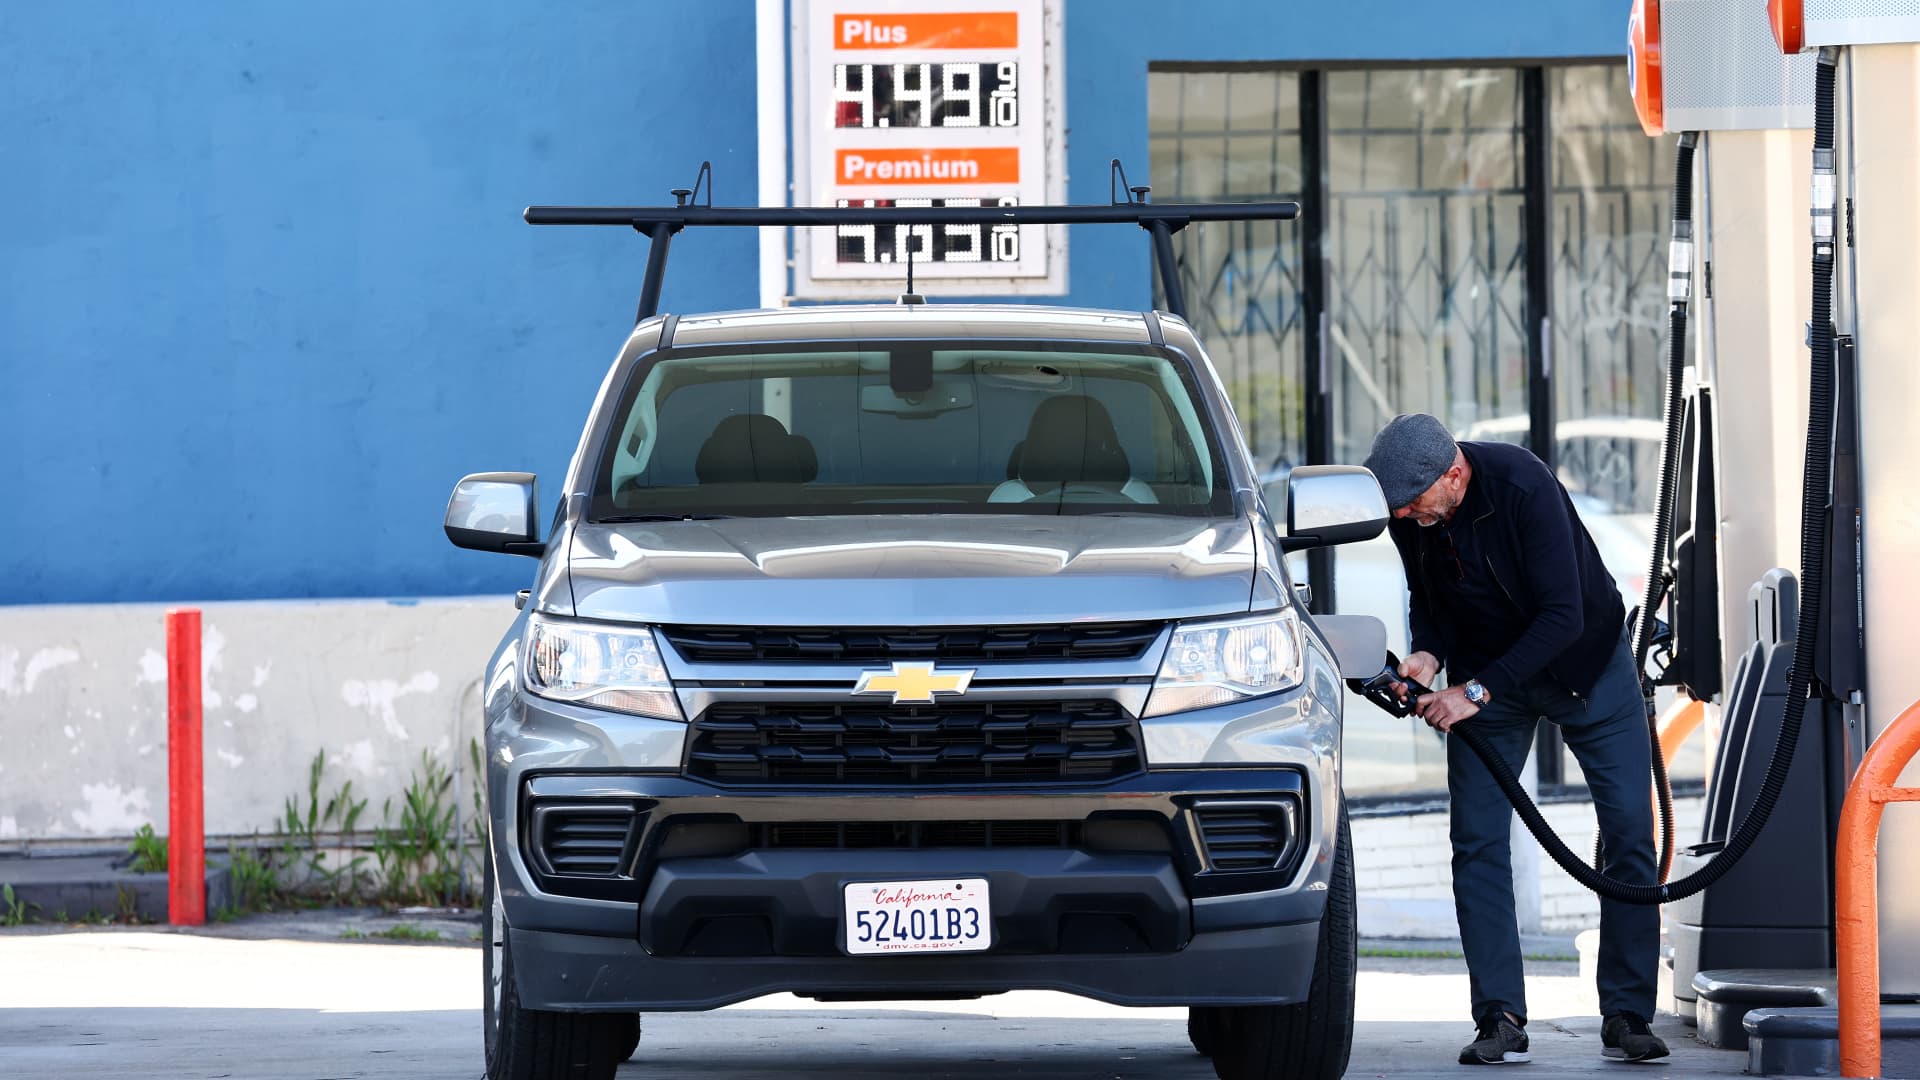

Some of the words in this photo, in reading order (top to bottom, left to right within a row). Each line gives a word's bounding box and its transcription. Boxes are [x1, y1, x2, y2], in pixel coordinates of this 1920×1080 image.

[842, 19, 907, 44] Plus
[844, 154, 979, 179] Premium
[875, 888, 960, 908] California
[856, 907, 980, 942] 52401B3
[883, 942, 955, 950] dmv.ca.gov
